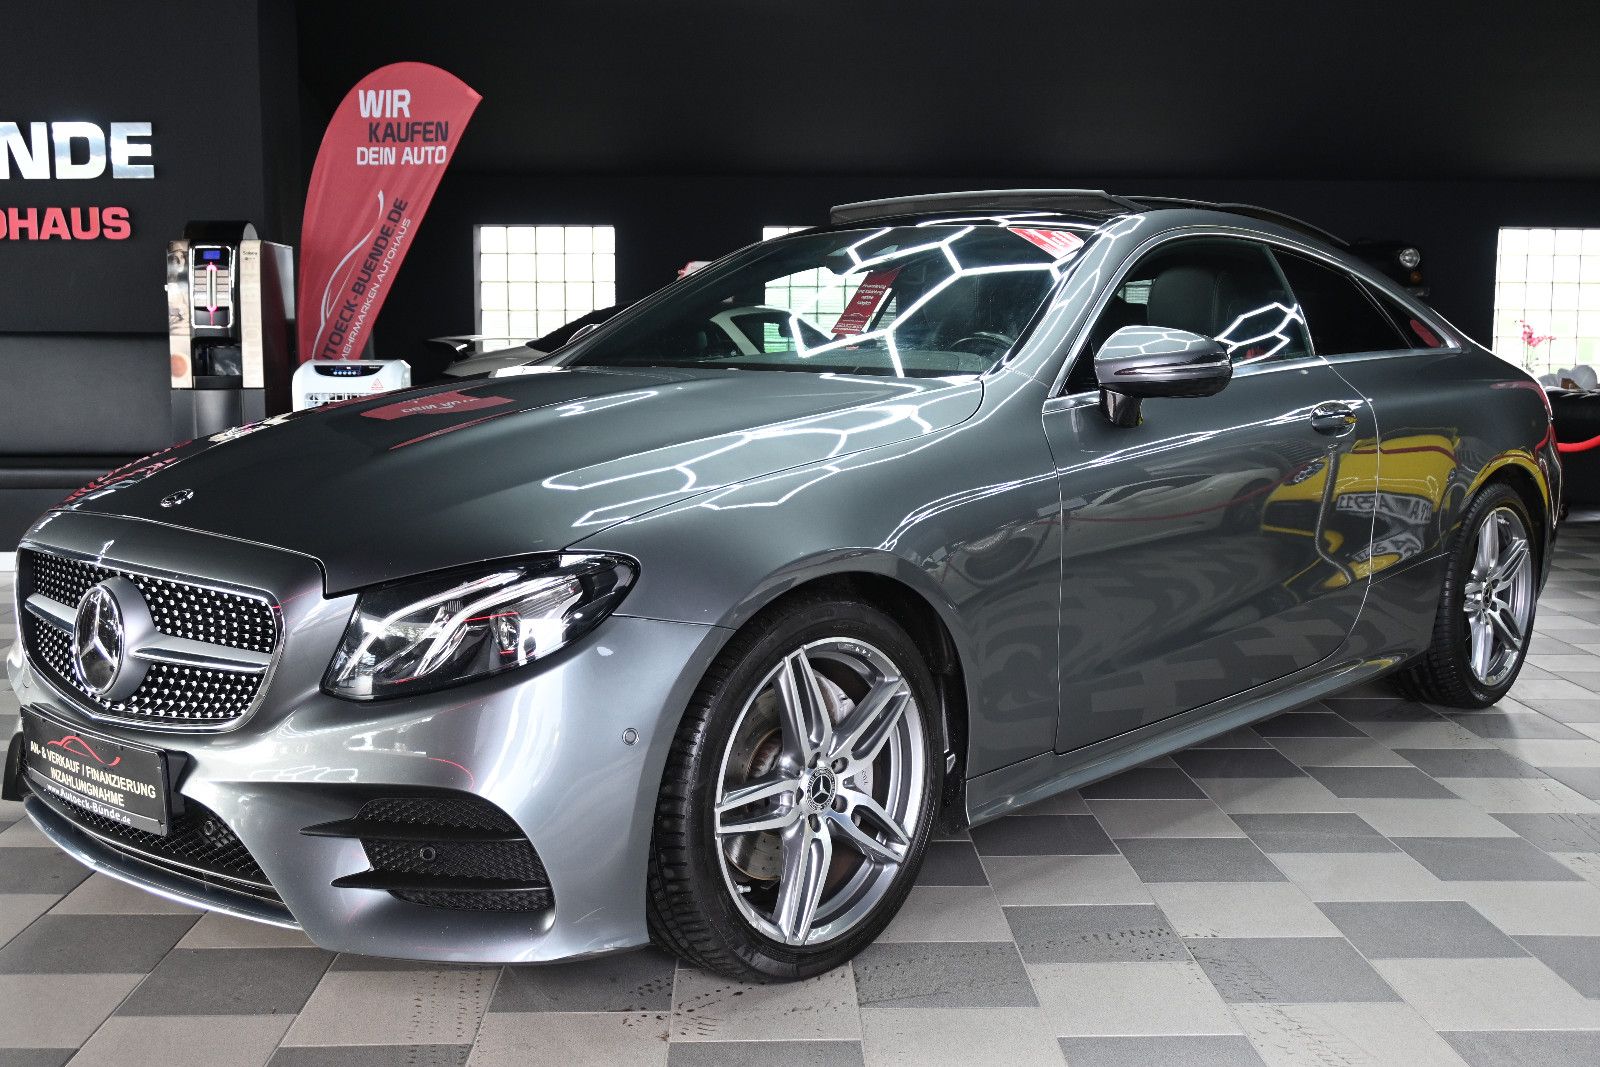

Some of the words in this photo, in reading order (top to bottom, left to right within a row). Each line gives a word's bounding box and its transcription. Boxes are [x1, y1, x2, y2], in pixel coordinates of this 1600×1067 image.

[358, 88, 411, 118] WIR
[368, 121, 449, 143] KAUFEN
[0, 121, 155, 179] NDE
[356, 146, 396, 166] DEIN
[401, 145, 447, 165] AUTO
[0, 206, 131, 240] HAUS
[376, 217, 411, 282] AUTOHAUS
[41, 746, 47, 759] &
[47, 748, 81, 774] VERKAUF
[85, 765, 157, 799] FINANZIERUNG
